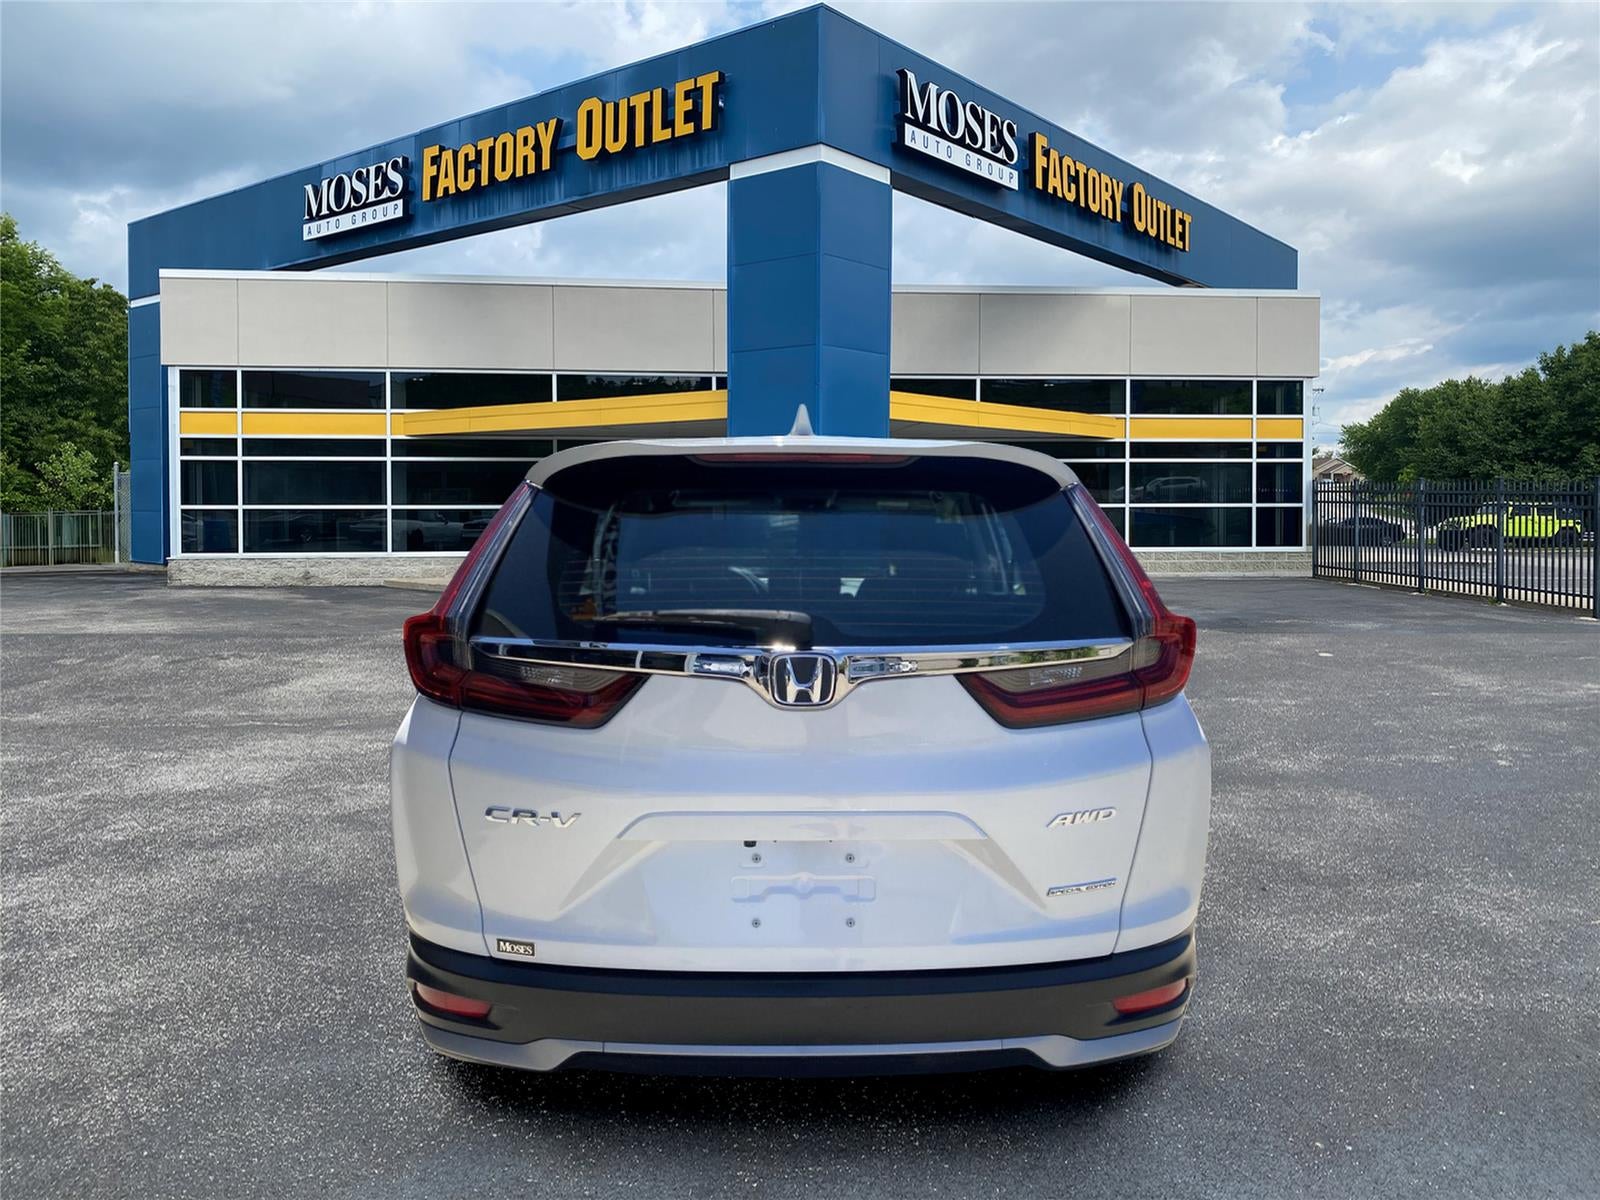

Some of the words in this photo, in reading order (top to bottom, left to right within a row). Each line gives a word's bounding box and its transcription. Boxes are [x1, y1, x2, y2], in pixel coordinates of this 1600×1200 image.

[422, 117, 560, 202] FACTORY
[576, 70, 721, 161] OUTLET
[904, 68, 1018, 165] MOSES
[910, 129, 954, 159] AUTO
[964, 150, 1015, 185] GROUP
[303, 155, 404, 220] MOSES
[1034, 132, 1124, 223] FACTORY
[1132, 182, 1192, 252] OUTLET
[307, 218, 340, 236] AUTO
[351, 203, 399, 225] GROUP
[484, 805, 582, 828] CR-V
[1046, 806, 1116, 831] AWD
[499, 941, 533, 955] MOSES
